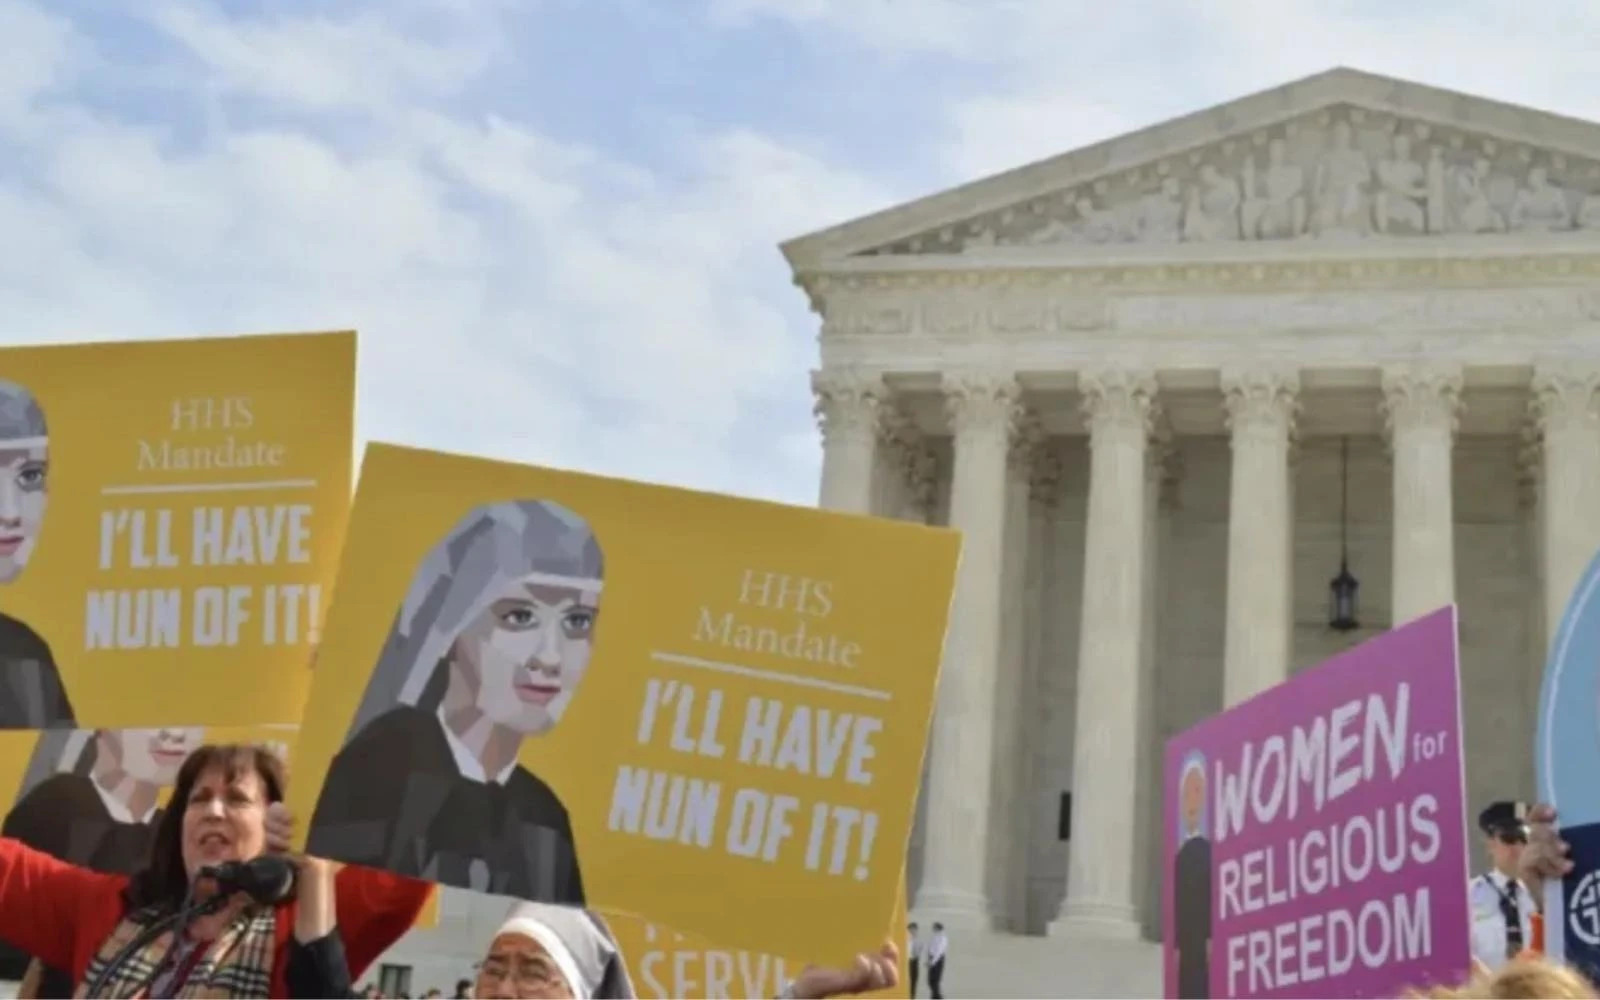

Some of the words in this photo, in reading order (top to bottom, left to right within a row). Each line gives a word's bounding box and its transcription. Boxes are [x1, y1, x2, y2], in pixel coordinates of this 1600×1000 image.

[171, 396, 254, 430] HHS
[136, 437, 285, 471] Mandate
[99, 509, 179, 569] I'LL
[191, 504, 312, 566] HAVE
[85, 587, 181, 650] NUN
[192, 584, 252, 647] OF
[263, 583, 321, 645] IT!
[739, 569, 833, 618] HHS
[692, 605, 863, 668] Mandate
[638, 678, 726, 758] I'LL
[737, 696, 884, 785] HAVE
[1214, 682, 1410, 843] WOMEN
[1413, 730, 1448, 762] for
[608, 765, 722, 849] NUN
[726, 787, 799, 863] OF
[805, 802, 879, 881] IT!
[1219, 794, 1441, 920] RELIGIOUS
[1227, 888, 1431, 997] FREEDOM
